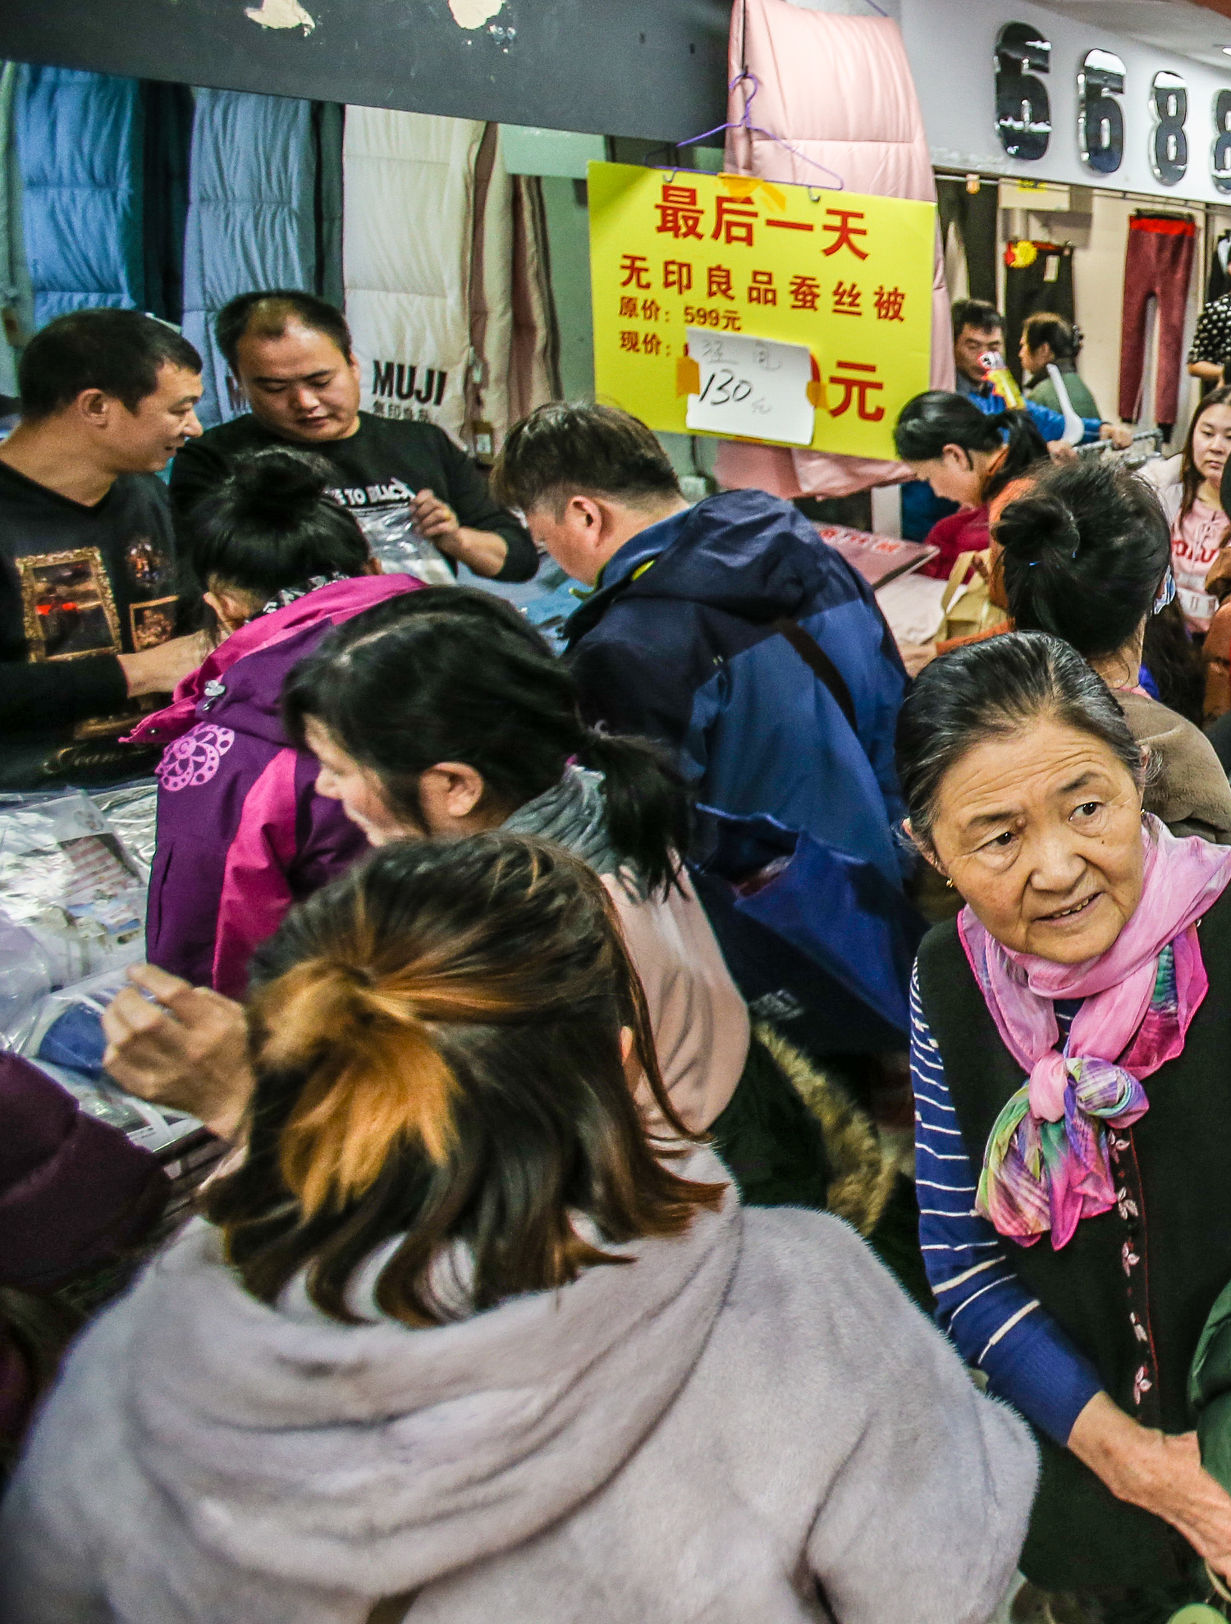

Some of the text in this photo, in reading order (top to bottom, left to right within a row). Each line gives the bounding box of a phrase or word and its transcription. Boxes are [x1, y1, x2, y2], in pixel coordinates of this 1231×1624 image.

[654, 184, 869, 260] 最后一天
[618, 296, 742, 332] 原价：599元
[620, 254, 906, 323] 无印良品蚕丝被
[372, 359, 448, 406] MUJI
[809, 353, 886, 422] 元
[343, 487, 367, 506] TO
